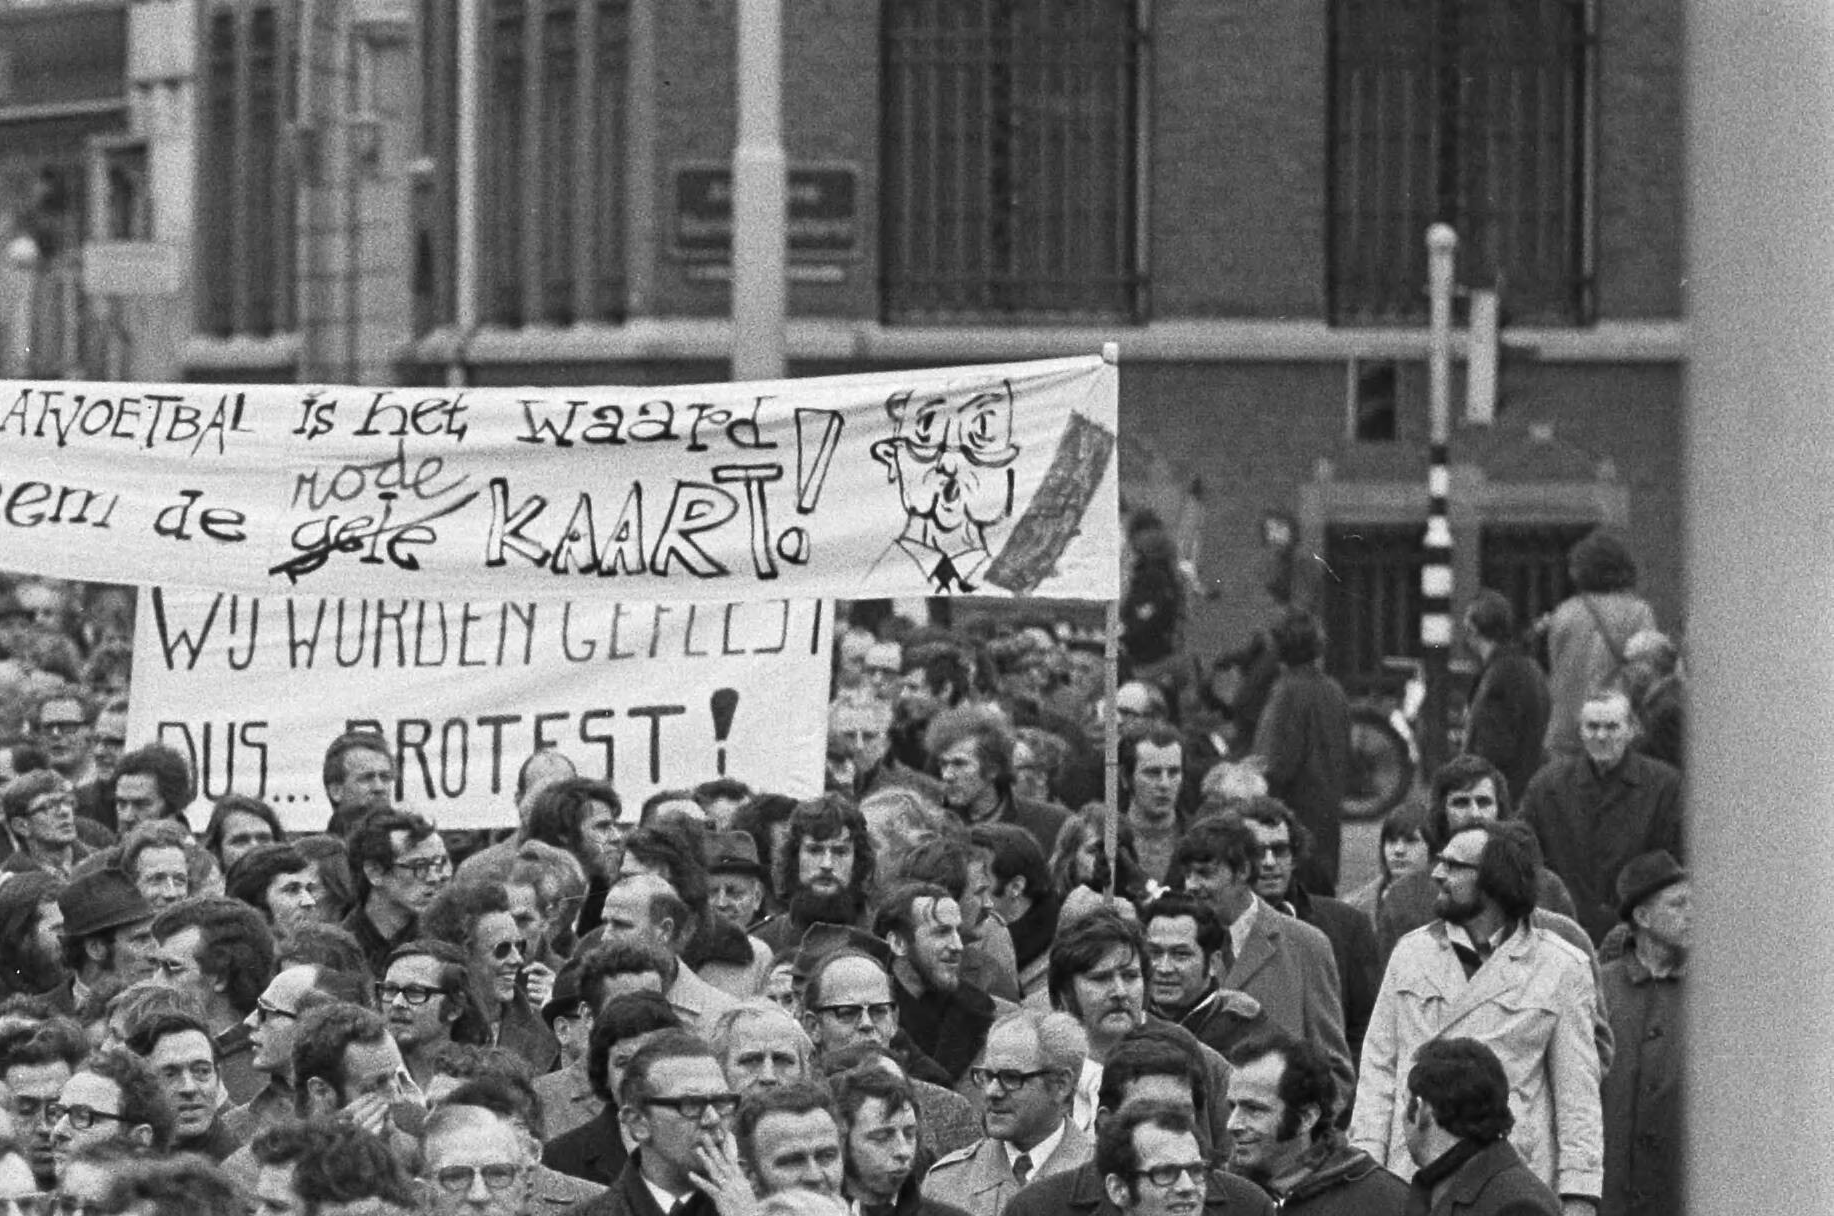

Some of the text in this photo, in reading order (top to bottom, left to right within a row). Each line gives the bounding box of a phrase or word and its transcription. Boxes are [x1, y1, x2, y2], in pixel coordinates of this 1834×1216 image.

[353, 391, 469, 441] het
[290, 438, 470, 512] rode
[152, 489, 248, 543] de
[151, 586, 261, 671] WIJ
